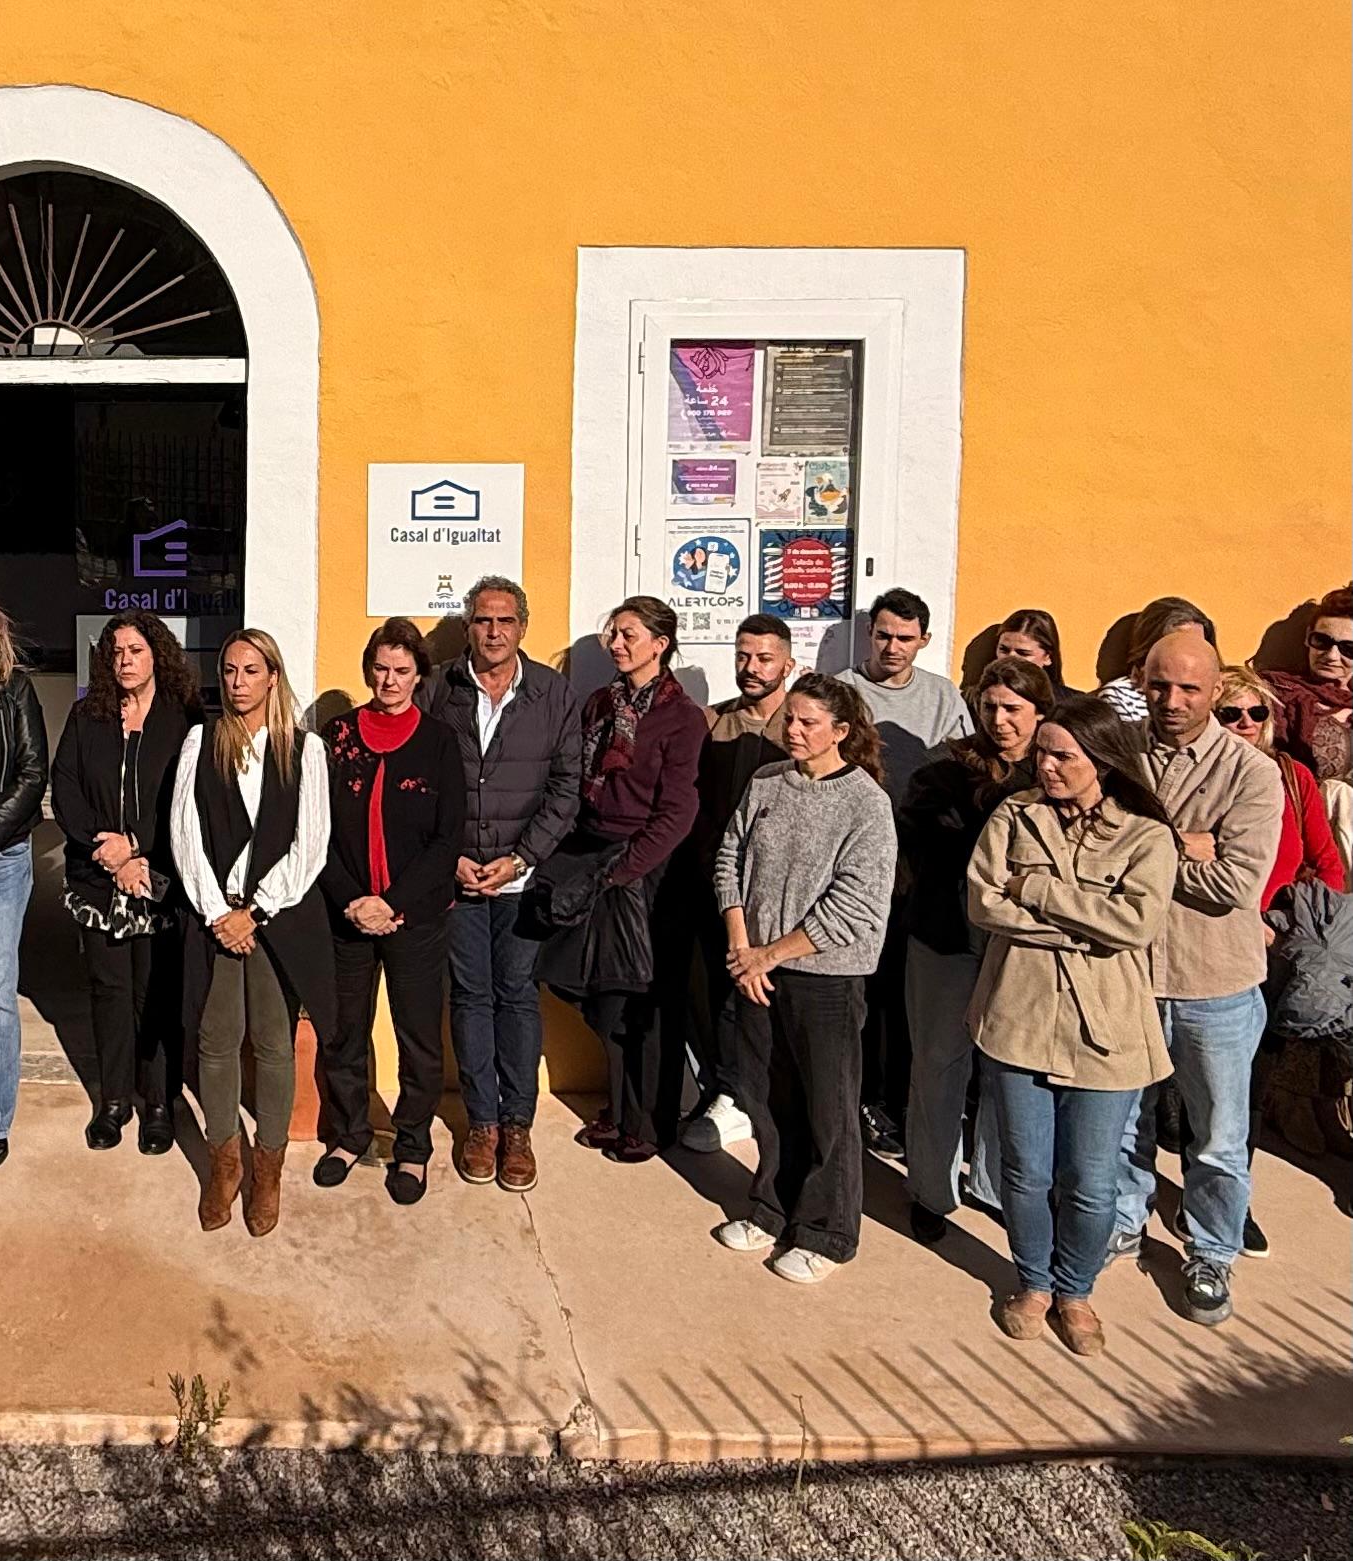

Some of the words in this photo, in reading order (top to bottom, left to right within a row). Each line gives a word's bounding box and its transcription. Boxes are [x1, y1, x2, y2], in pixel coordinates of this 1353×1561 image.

[711, 396, 729, 406] 24
[390, 527, 428, 543] Casal
[433, 527, 502, 546] d'Igualtat
[105, 588, 158, 610] Casal
[668, 596, 744, 607] ALERTCOPS
[428, 601, 461, 609] eivissa
